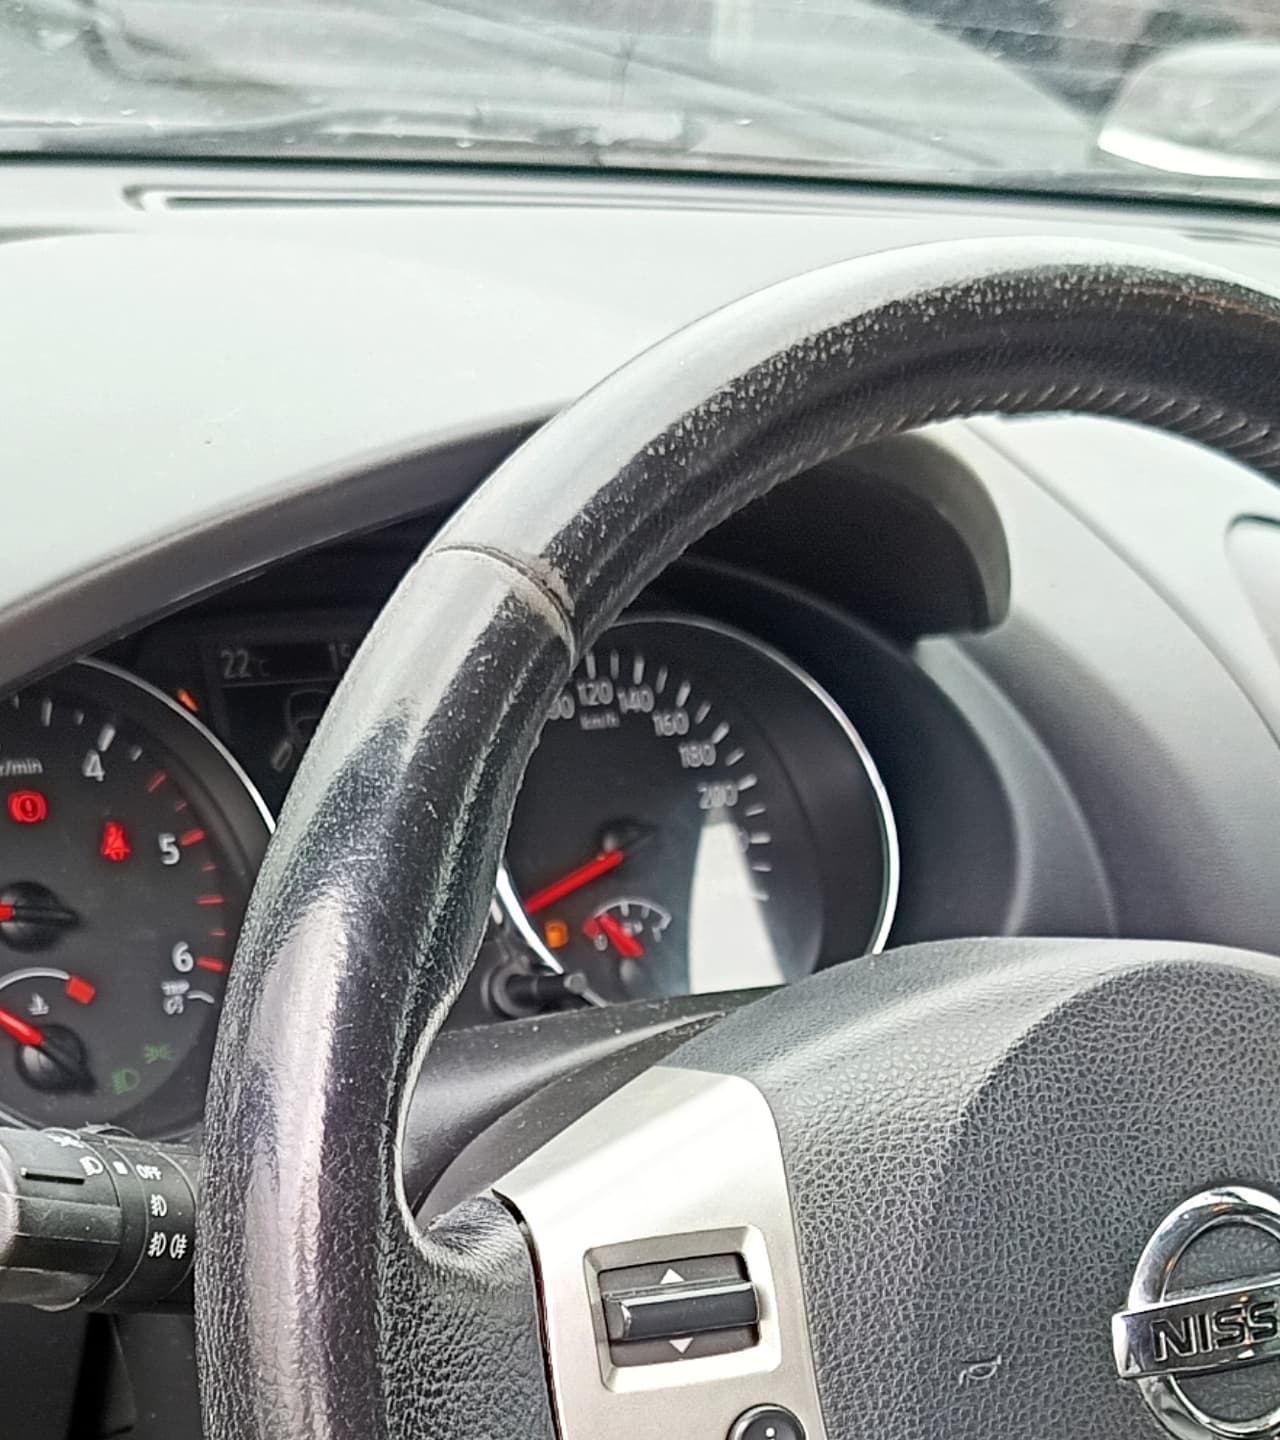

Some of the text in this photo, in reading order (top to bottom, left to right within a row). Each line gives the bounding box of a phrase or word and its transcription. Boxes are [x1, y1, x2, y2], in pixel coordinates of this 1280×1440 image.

[221, 648, 250, 678] 22
[577, 676, 614, 705] 120
[617, 684, 655, 714] 140
[652, 708, 690, 737] 160
[83, 749, 106, 783] 4
[678, 741, 717, 768] 180
[697, 782, 739, 809] 200
[158, 832, 180, 865] 5
[172, 941, 194, 973] 6
[135, 1163, 162, 1181] OFF
